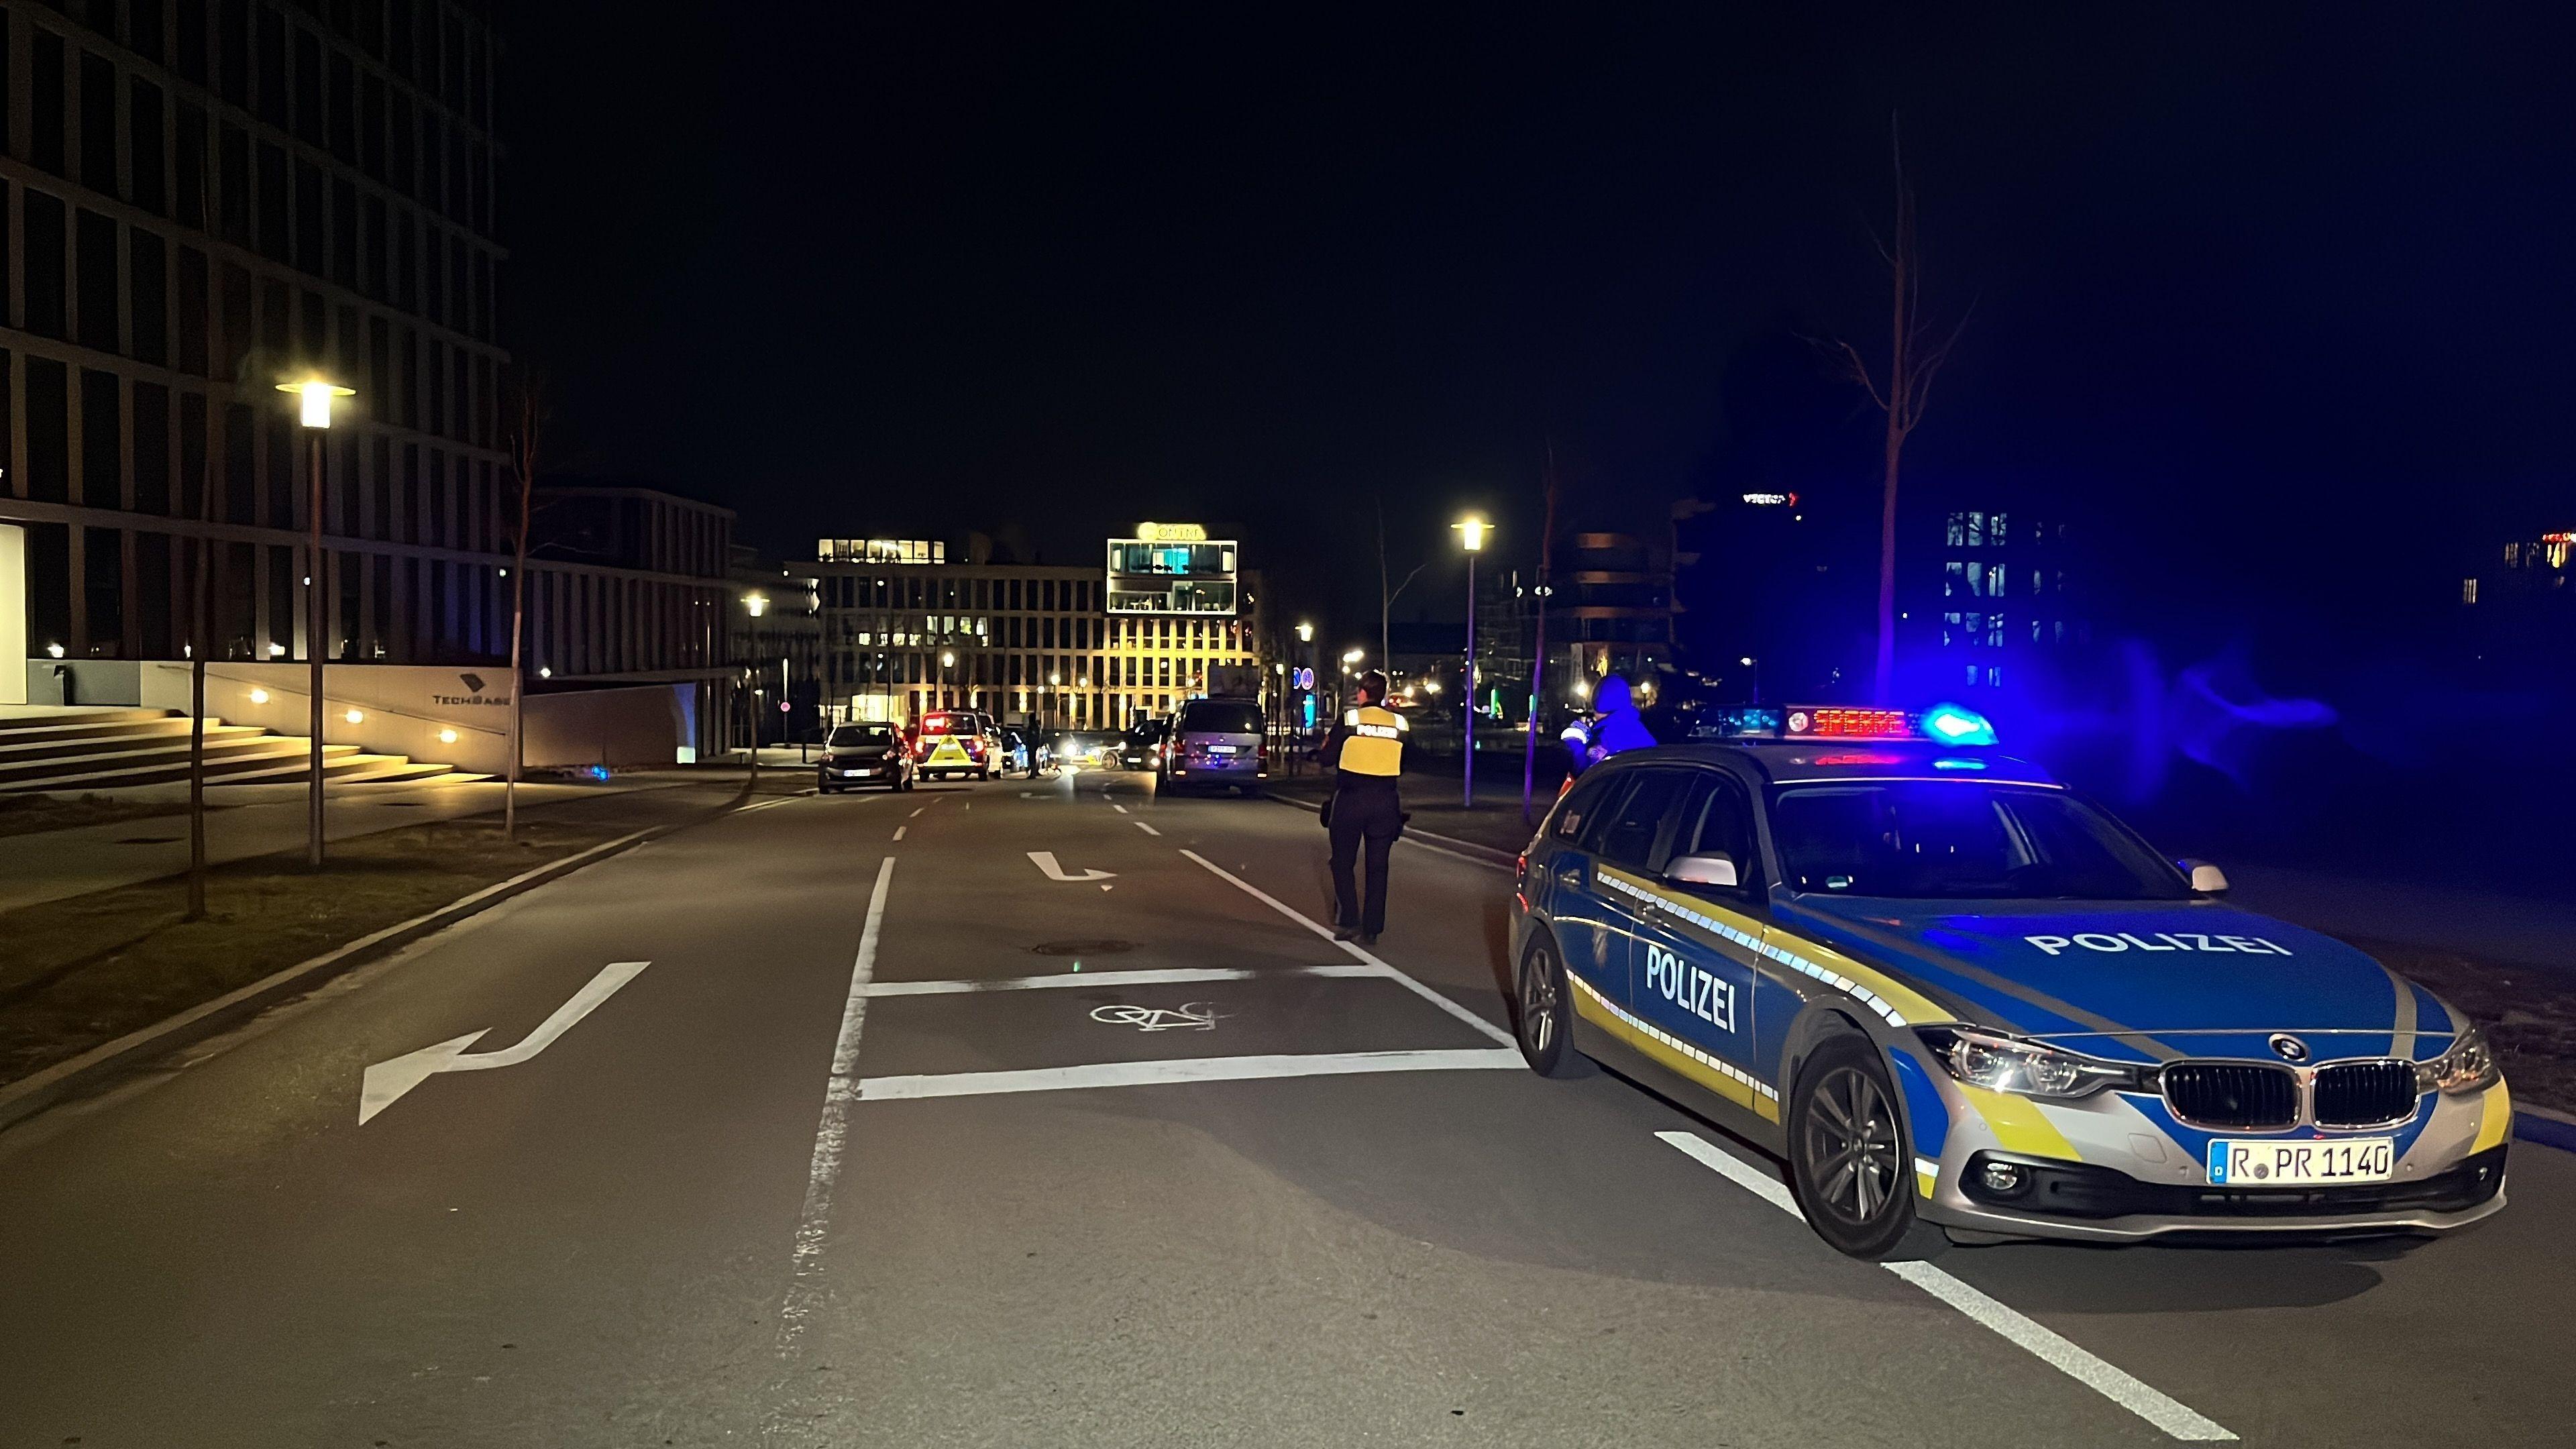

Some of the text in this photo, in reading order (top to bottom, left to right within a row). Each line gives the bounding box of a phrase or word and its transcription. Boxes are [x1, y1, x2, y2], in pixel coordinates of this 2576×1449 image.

[1813, 710, 1904, 733] SPERRE
[2023, 932, 2294, 956] POLIZEI
[1646, 943, 1735, 1034] POLIZEI
[2231, 1145, 2389, 1177] R PR 1140
